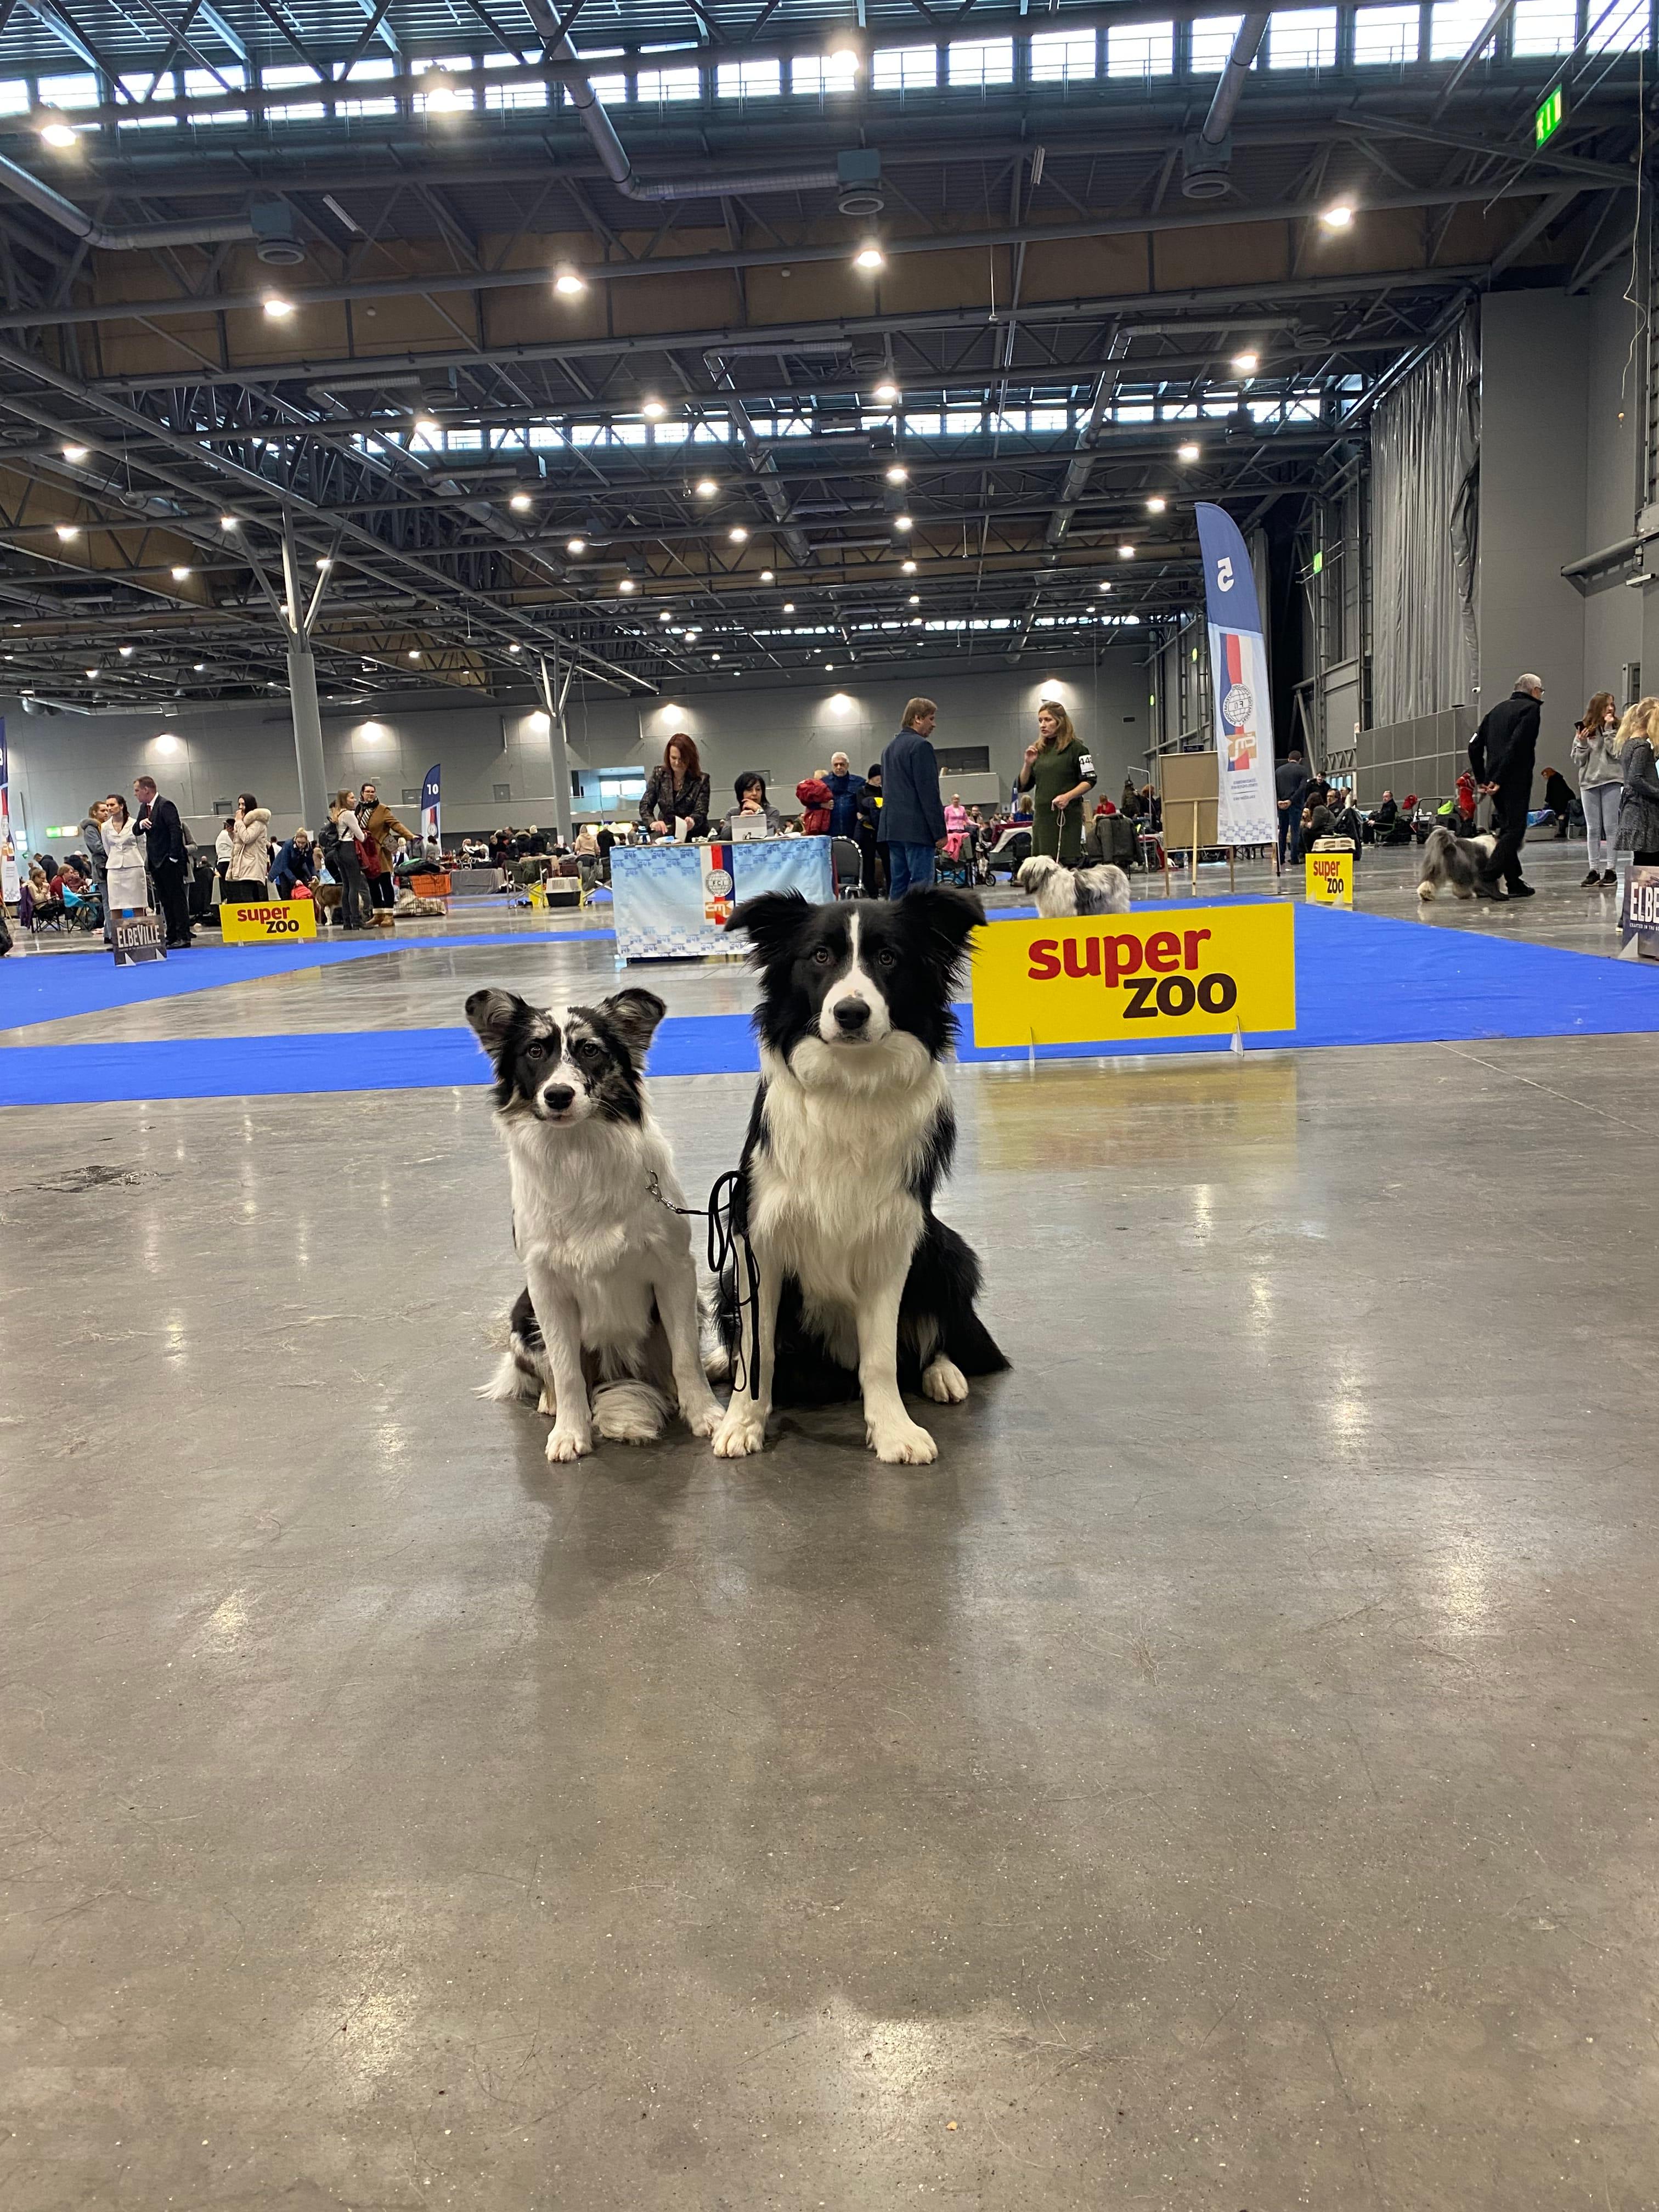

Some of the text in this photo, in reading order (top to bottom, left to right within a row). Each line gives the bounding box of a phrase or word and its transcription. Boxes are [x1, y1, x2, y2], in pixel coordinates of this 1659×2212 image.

[427, 783, 439, 795] 10
[1313, 861, 1340, 881] super
[1327, 878, 1344, 894] zoo
[237, 906, 290, 924] super
[116, 924, 161, 948] ELBEVILLE
[266, 920, 300, 934] zoo
[1028, 928, 1211, 988] super
[1122, 973, 1238, 1019] zoo
